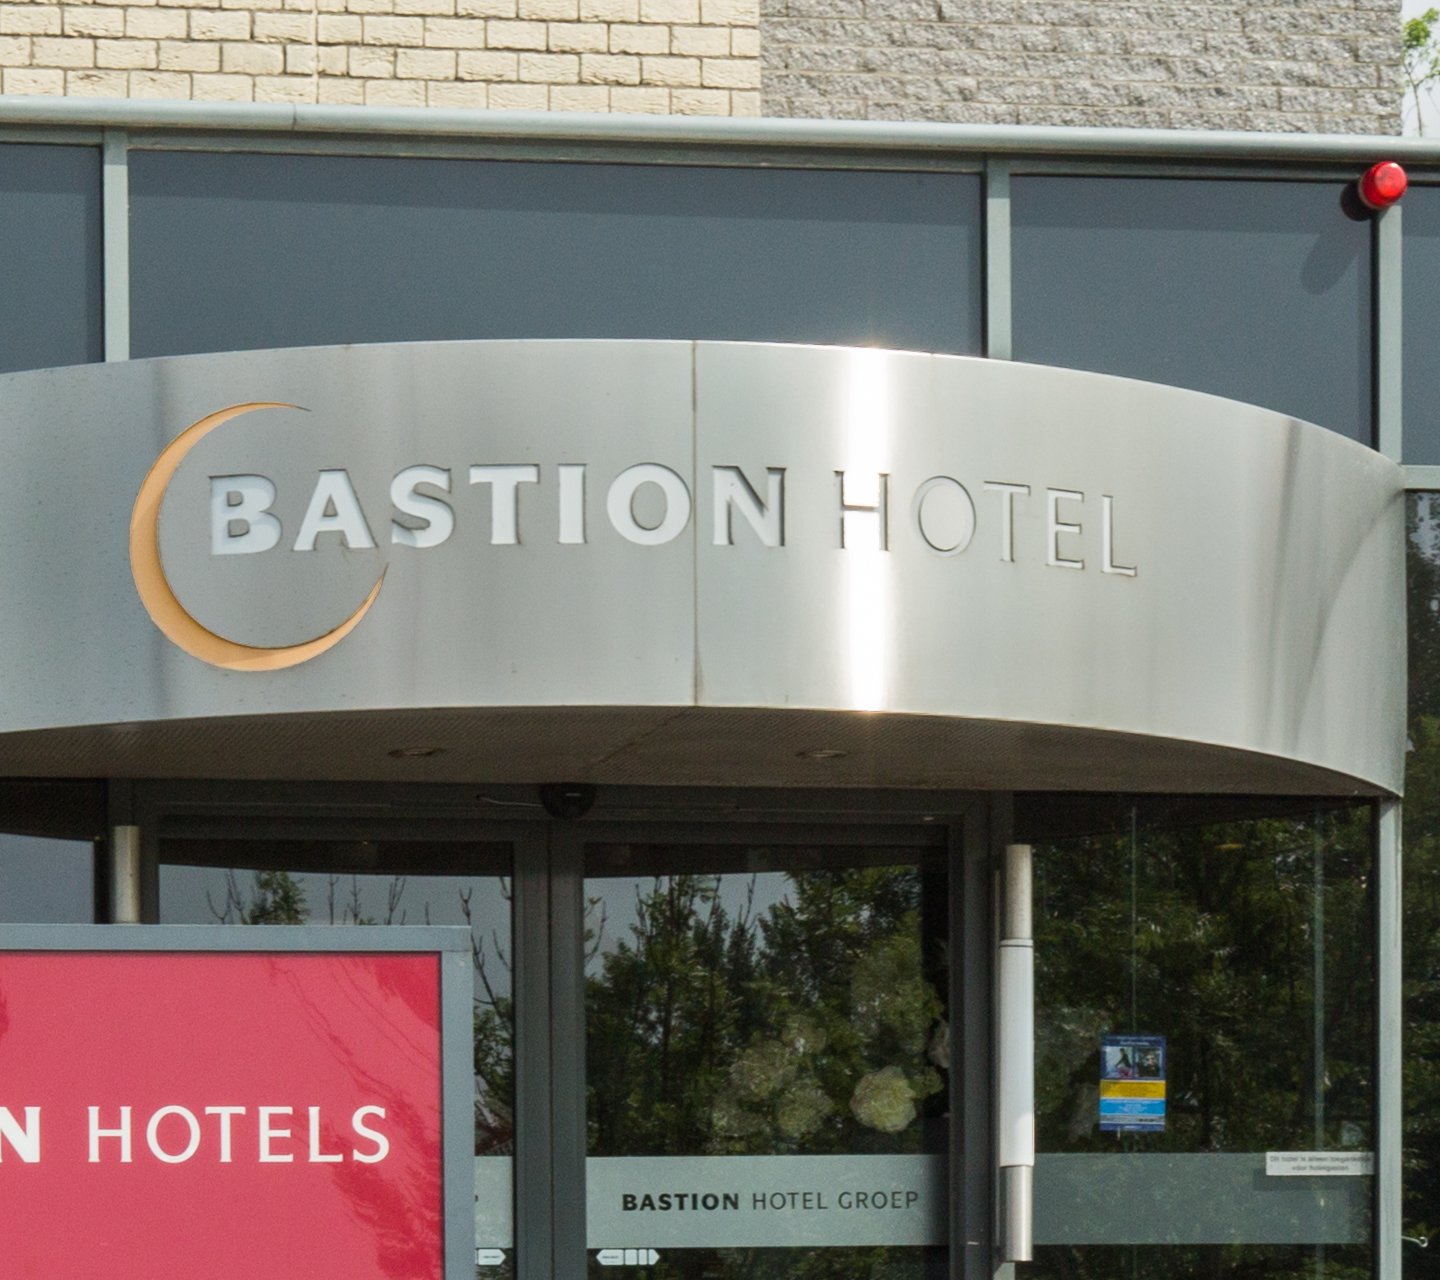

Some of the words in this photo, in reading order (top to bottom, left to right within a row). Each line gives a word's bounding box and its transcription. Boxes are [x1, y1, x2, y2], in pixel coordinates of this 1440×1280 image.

[210, 462, 788, 556] BASTION
[834, 469, 1138, 577] HOTEL
[87, 1104, 390, 1164] HOTELS
[622, 1193, 740, 1211] BASTION
[753, 1191, 828, 1210] HOTEL
[838, 1190, 919, 1210] GROEP
